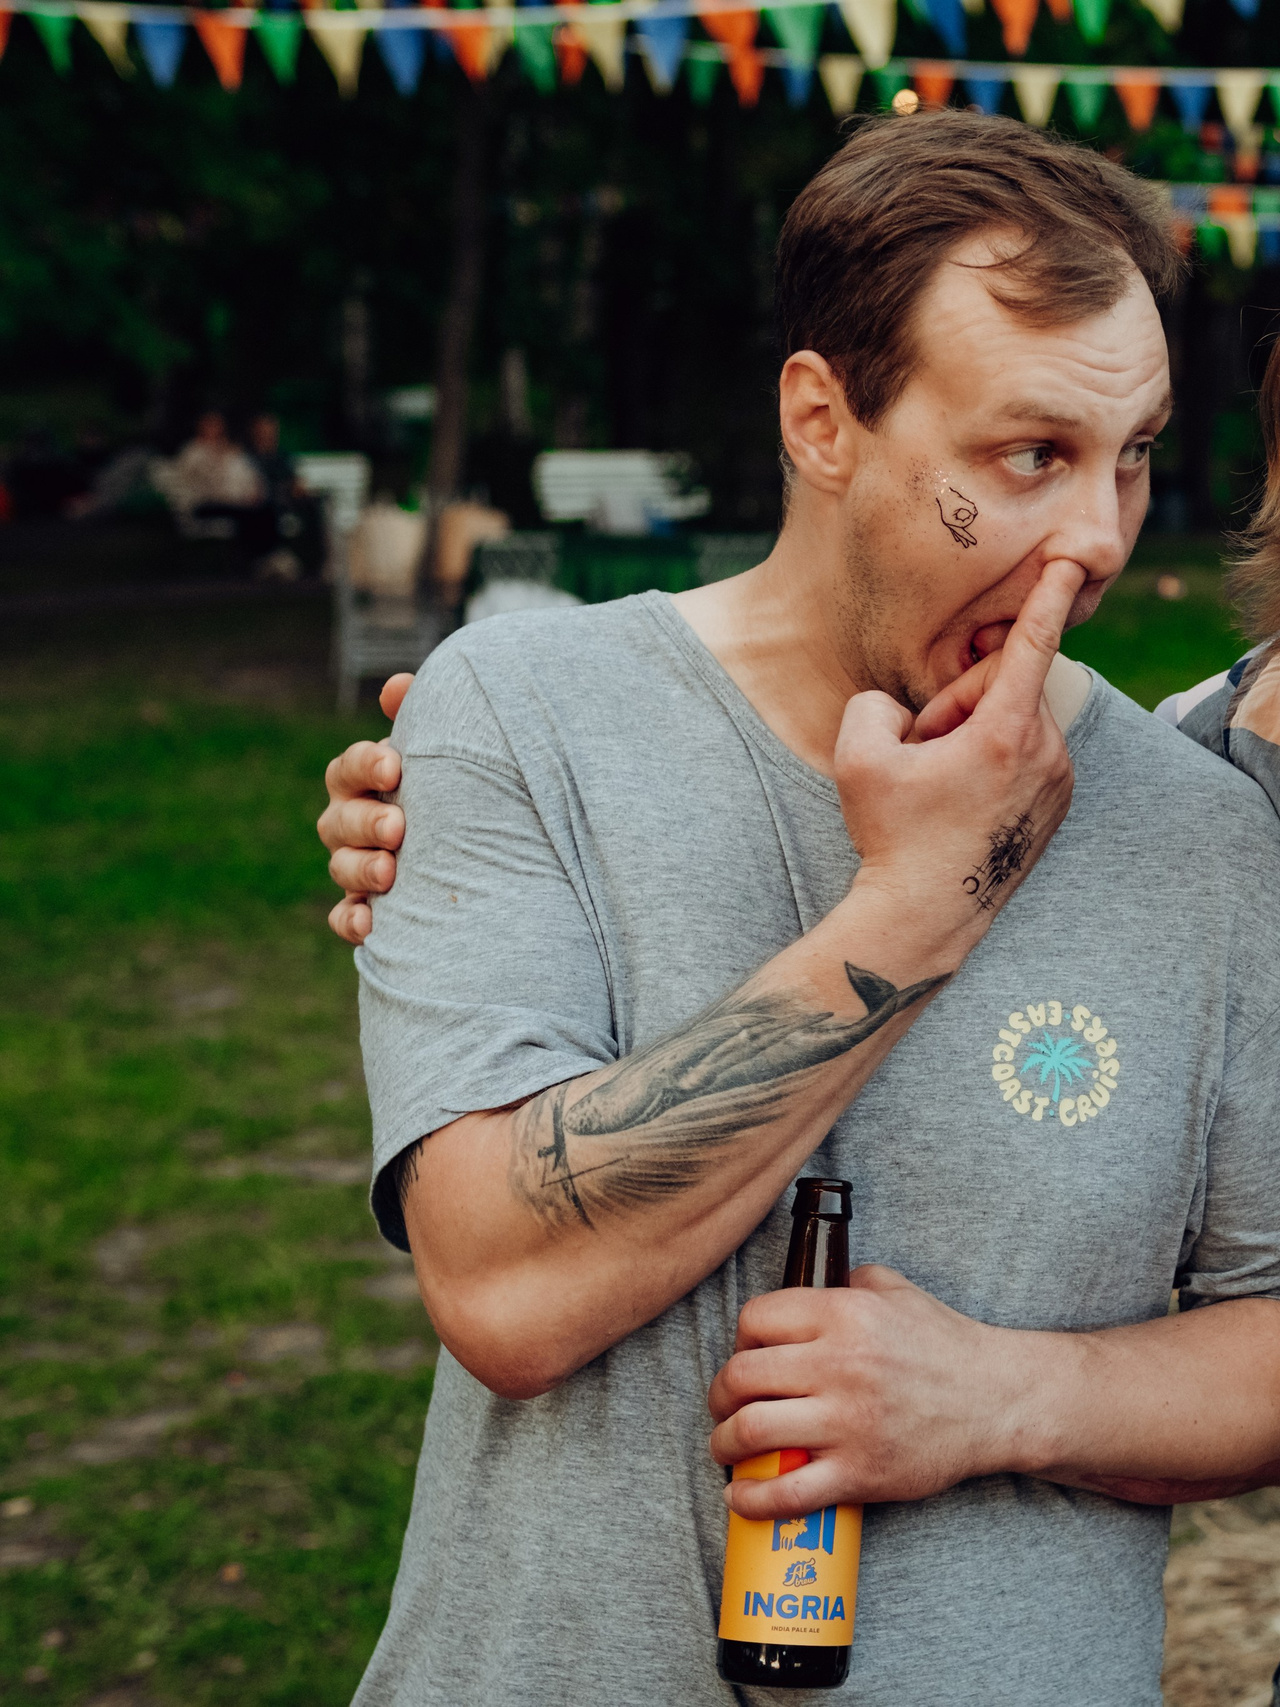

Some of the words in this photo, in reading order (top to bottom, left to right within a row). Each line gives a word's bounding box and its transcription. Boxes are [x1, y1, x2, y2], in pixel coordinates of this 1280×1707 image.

[998, 1000, 1062, 1047] EAST
[991, 1043, 1050, 1121] COAST
[783, 1557, 816, 1586] AF
[743, 1591, 846, 1621] INGRIA
